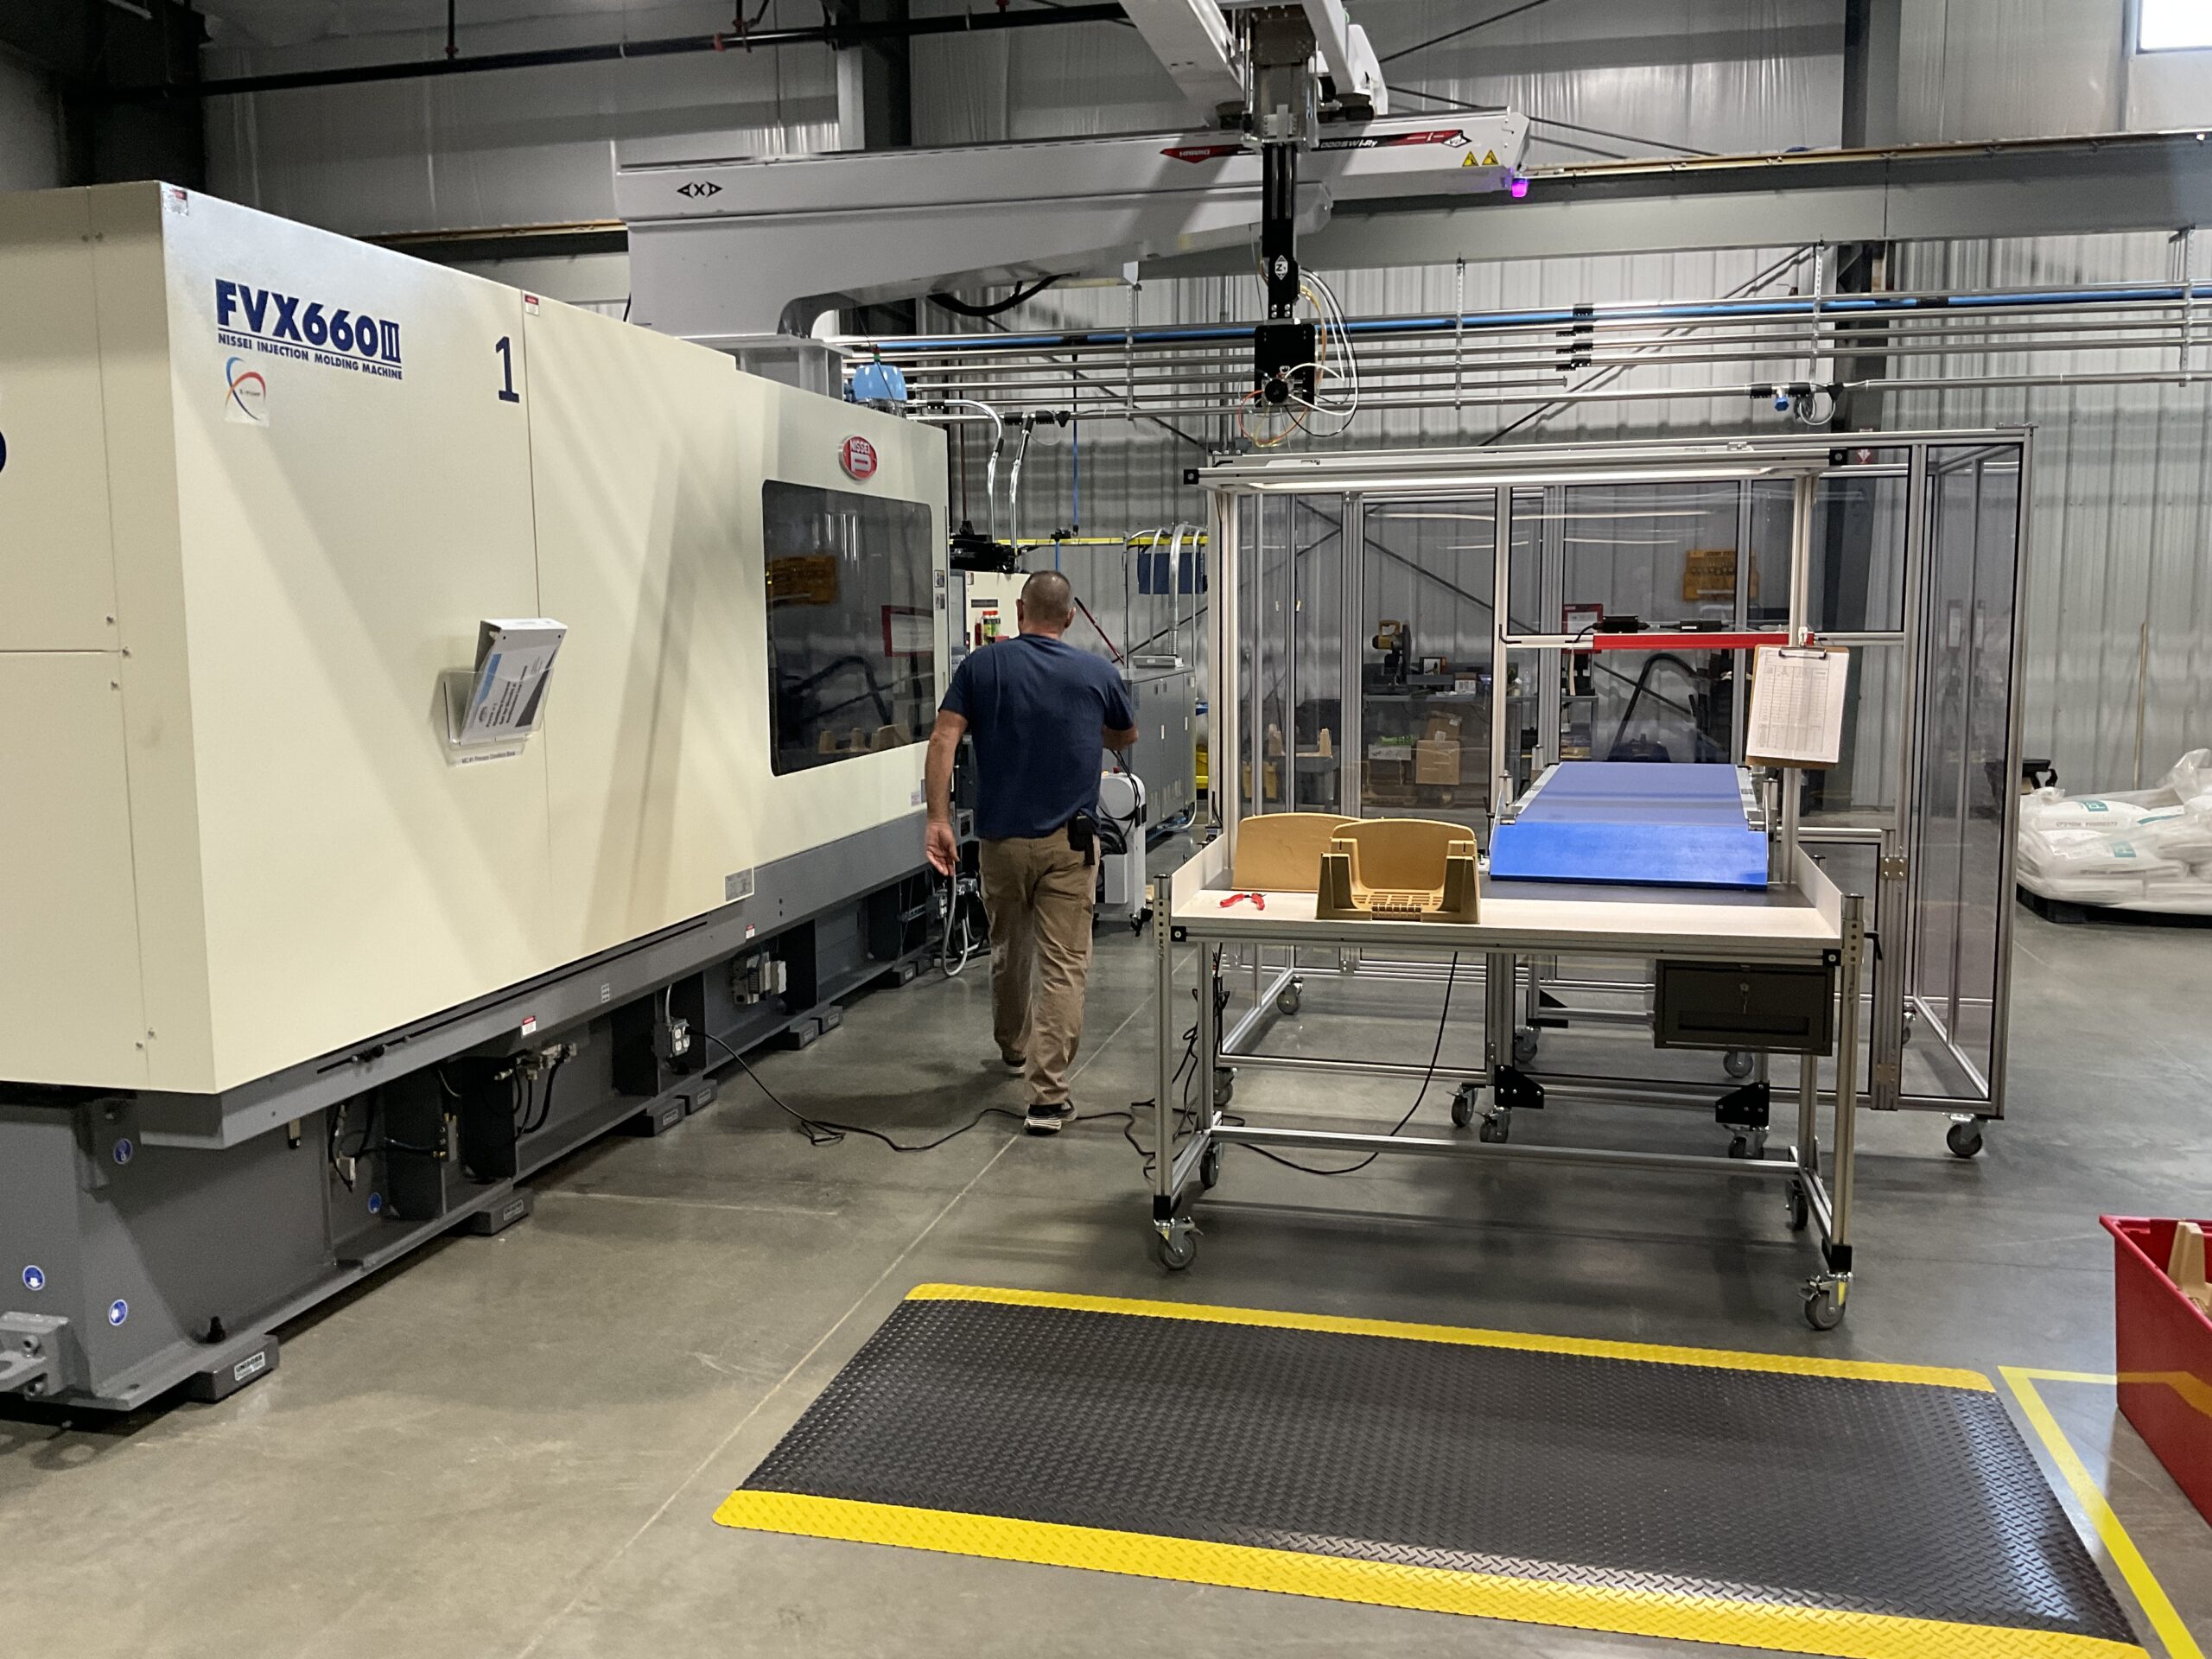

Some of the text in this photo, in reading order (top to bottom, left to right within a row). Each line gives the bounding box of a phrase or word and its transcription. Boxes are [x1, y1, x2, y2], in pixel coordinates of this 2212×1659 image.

[218, 333, 403, 380] NISSEI INJECTION MOLDING MACHINE
[495, 335, 520, 404] 1
[849, 439, 871, 455] NISSEI
